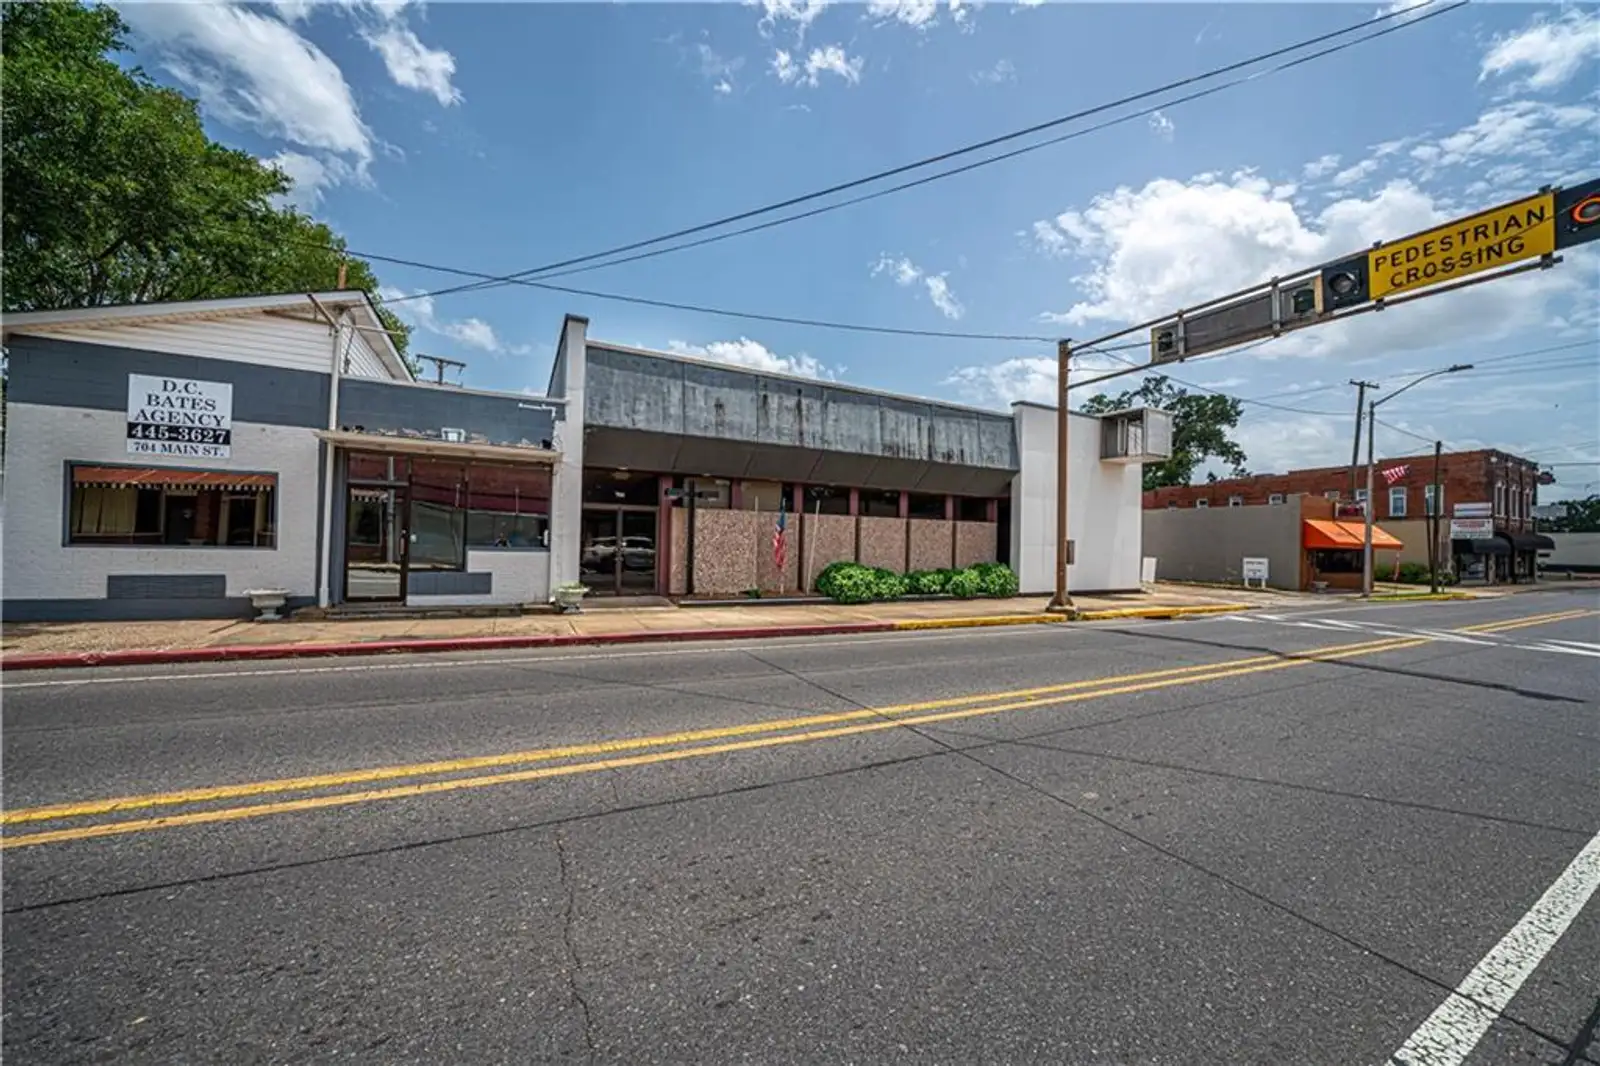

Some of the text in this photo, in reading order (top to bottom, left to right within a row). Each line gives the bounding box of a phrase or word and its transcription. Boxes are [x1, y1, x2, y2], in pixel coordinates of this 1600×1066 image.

[1374, 205, 1545, 272] PEDESTRIAN
[1390, 236, 1525, 288] CROSSING
[162, 379, 202, 395] D.C.
[146, 394, 216, 412] BATES
[134, 408, 225, 427] AGENCY
[131, 424, 226, 443] 445-3627
[160, 443, 199, 455] MAIN
[202, 446, 225, 457] ST.
